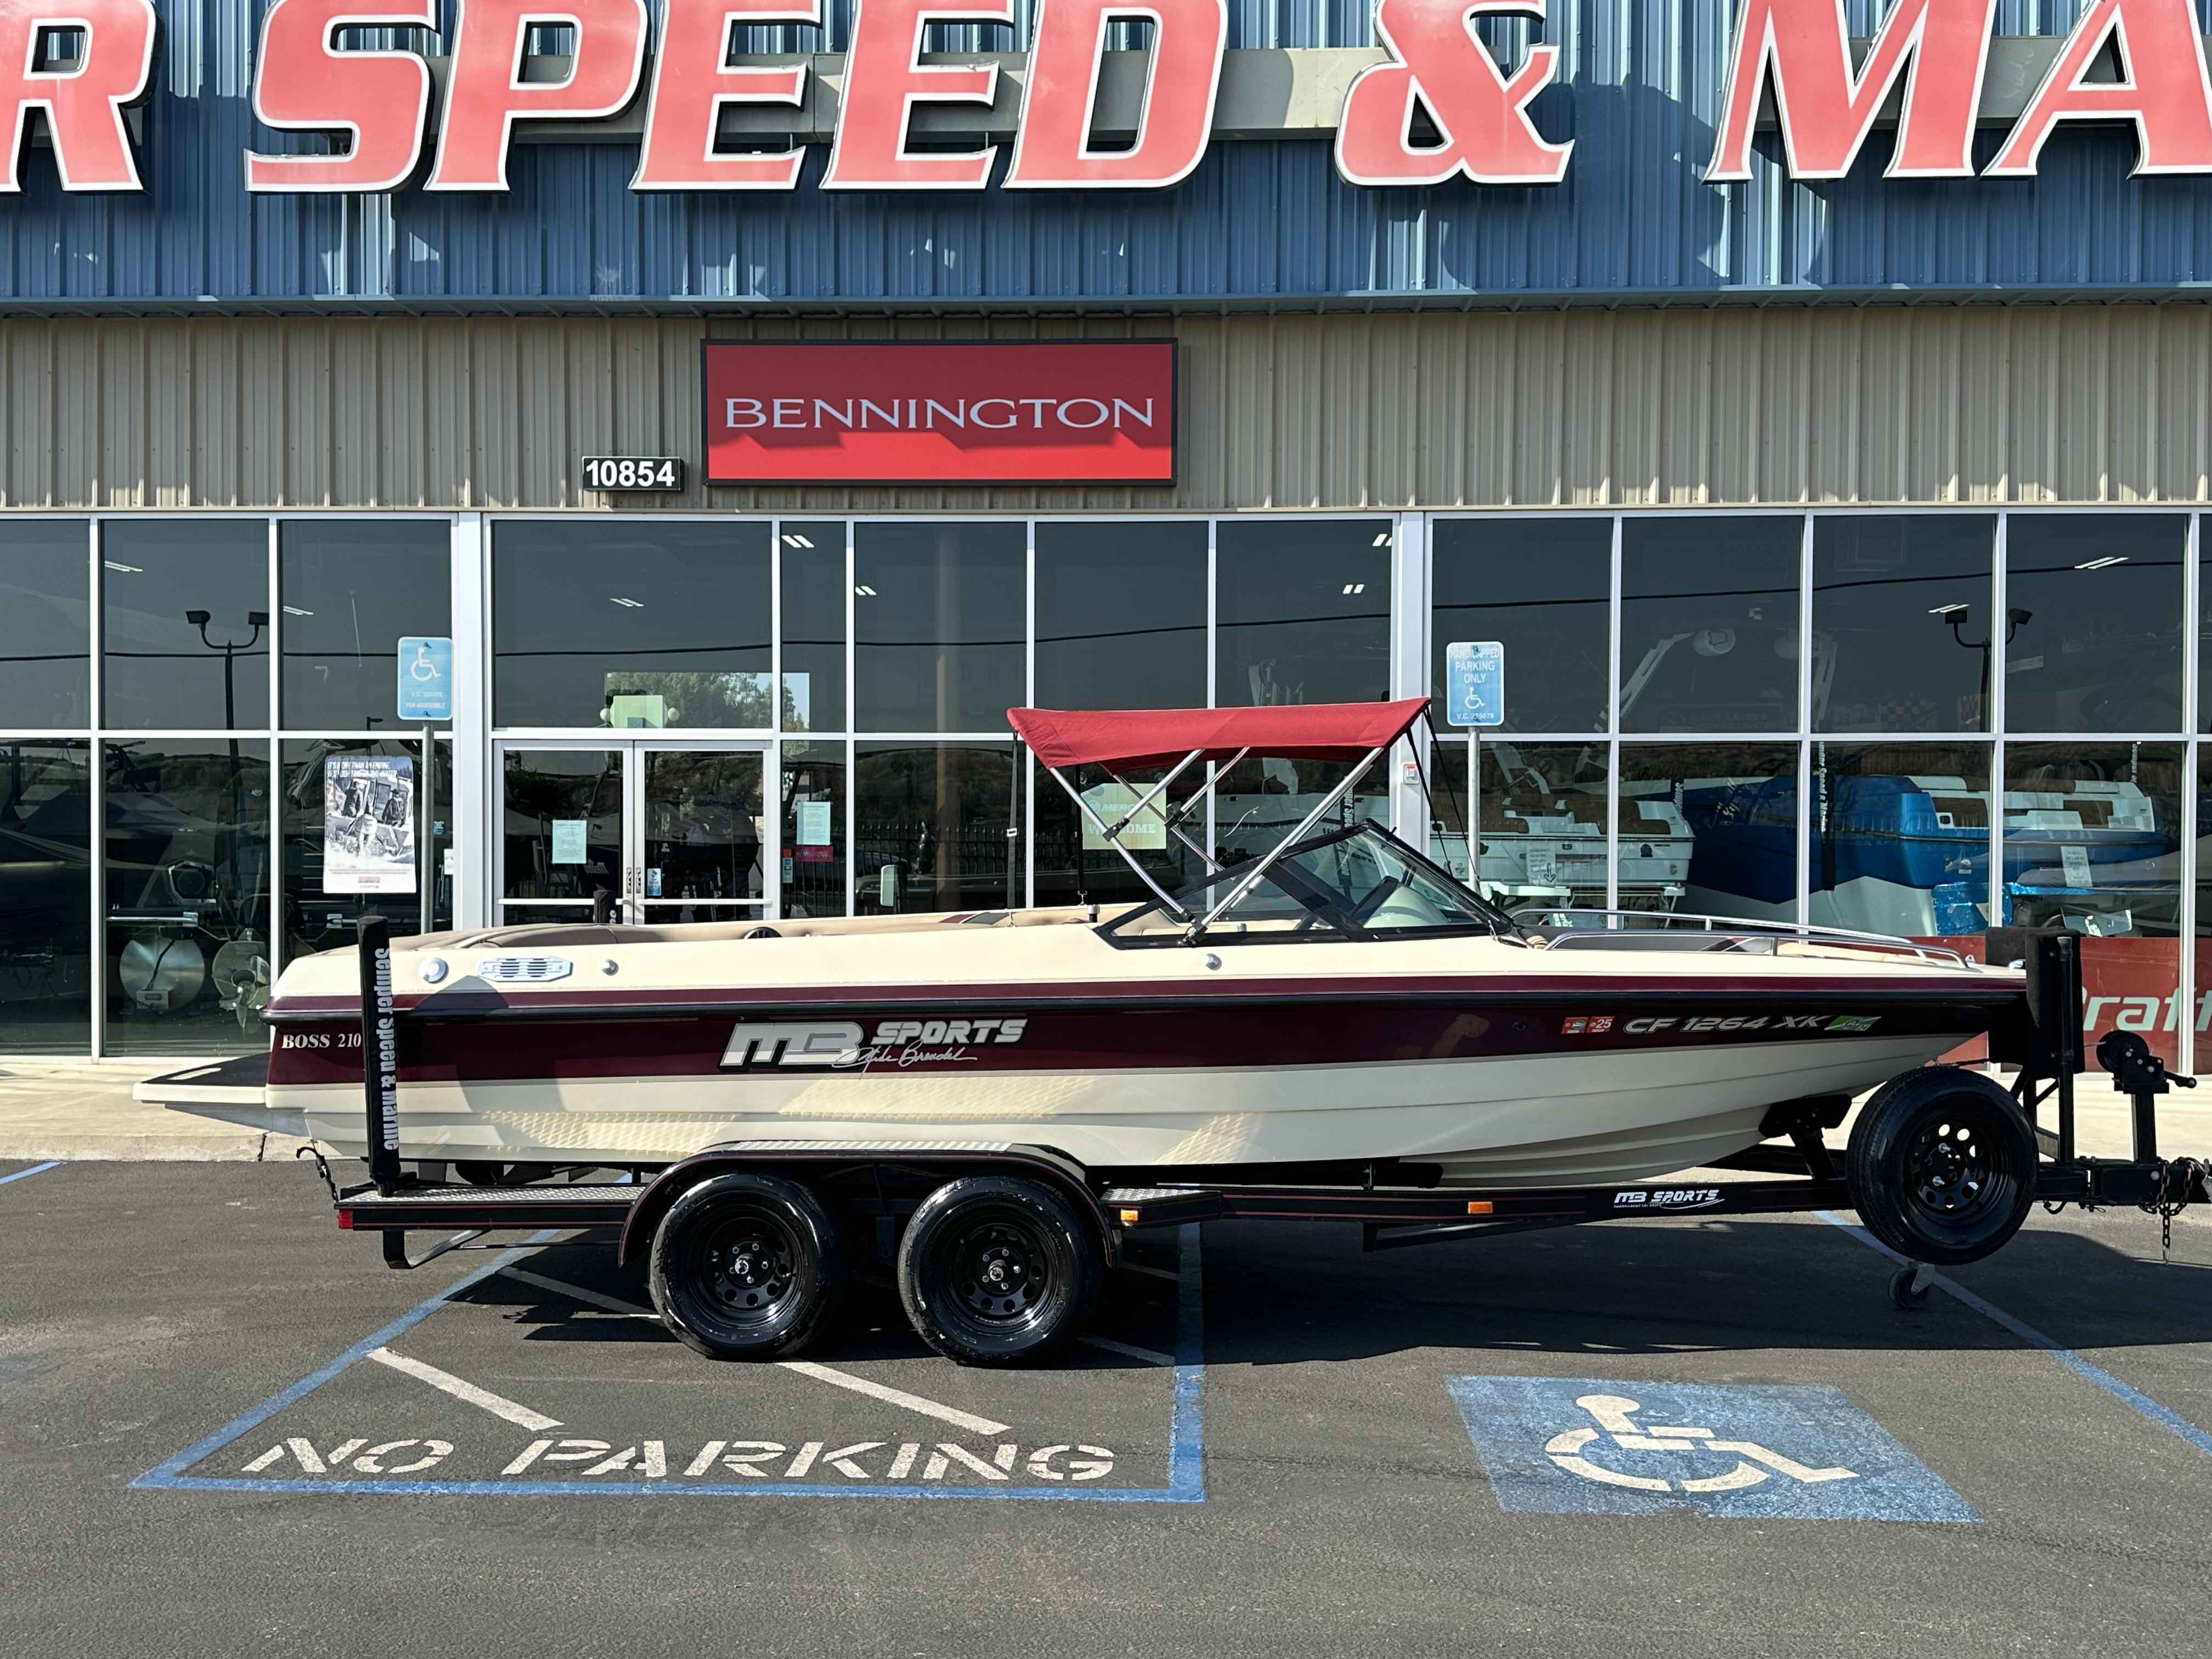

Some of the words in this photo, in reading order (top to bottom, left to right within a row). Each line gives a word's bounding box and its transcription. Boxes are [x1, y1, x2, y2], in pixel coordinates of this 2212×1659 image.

[244, 0, 1228, 194] SPEED
[1333, 0, 1576, 187] &
[725, 398, 1154, 430] BENNINGTON
[585, 460, 675, 488] 10854
[1455, 661, 1495, 672] PARKING
[1464, 673, 1486, 684] ONLY
[870, 1019, 1028, 1045] SPORTS
[1595, 1019, 1613, 1029] 25
[1624, 1018, 1680, 1034] CF
[1681, 1016, 1770, 1032] 1264
[1770, 1015, 1833, 1029] XK
[281, 1034, 330, 1049] BOSS
[337, 1032, 362, 1047] 210
[381, 1075, 397, 1088] &
[1650, 1189, 1720, 1203] SPORTS
[240, 1436, 455, 1475] NO
[501, 1438, 1115, 1482] PARKING
